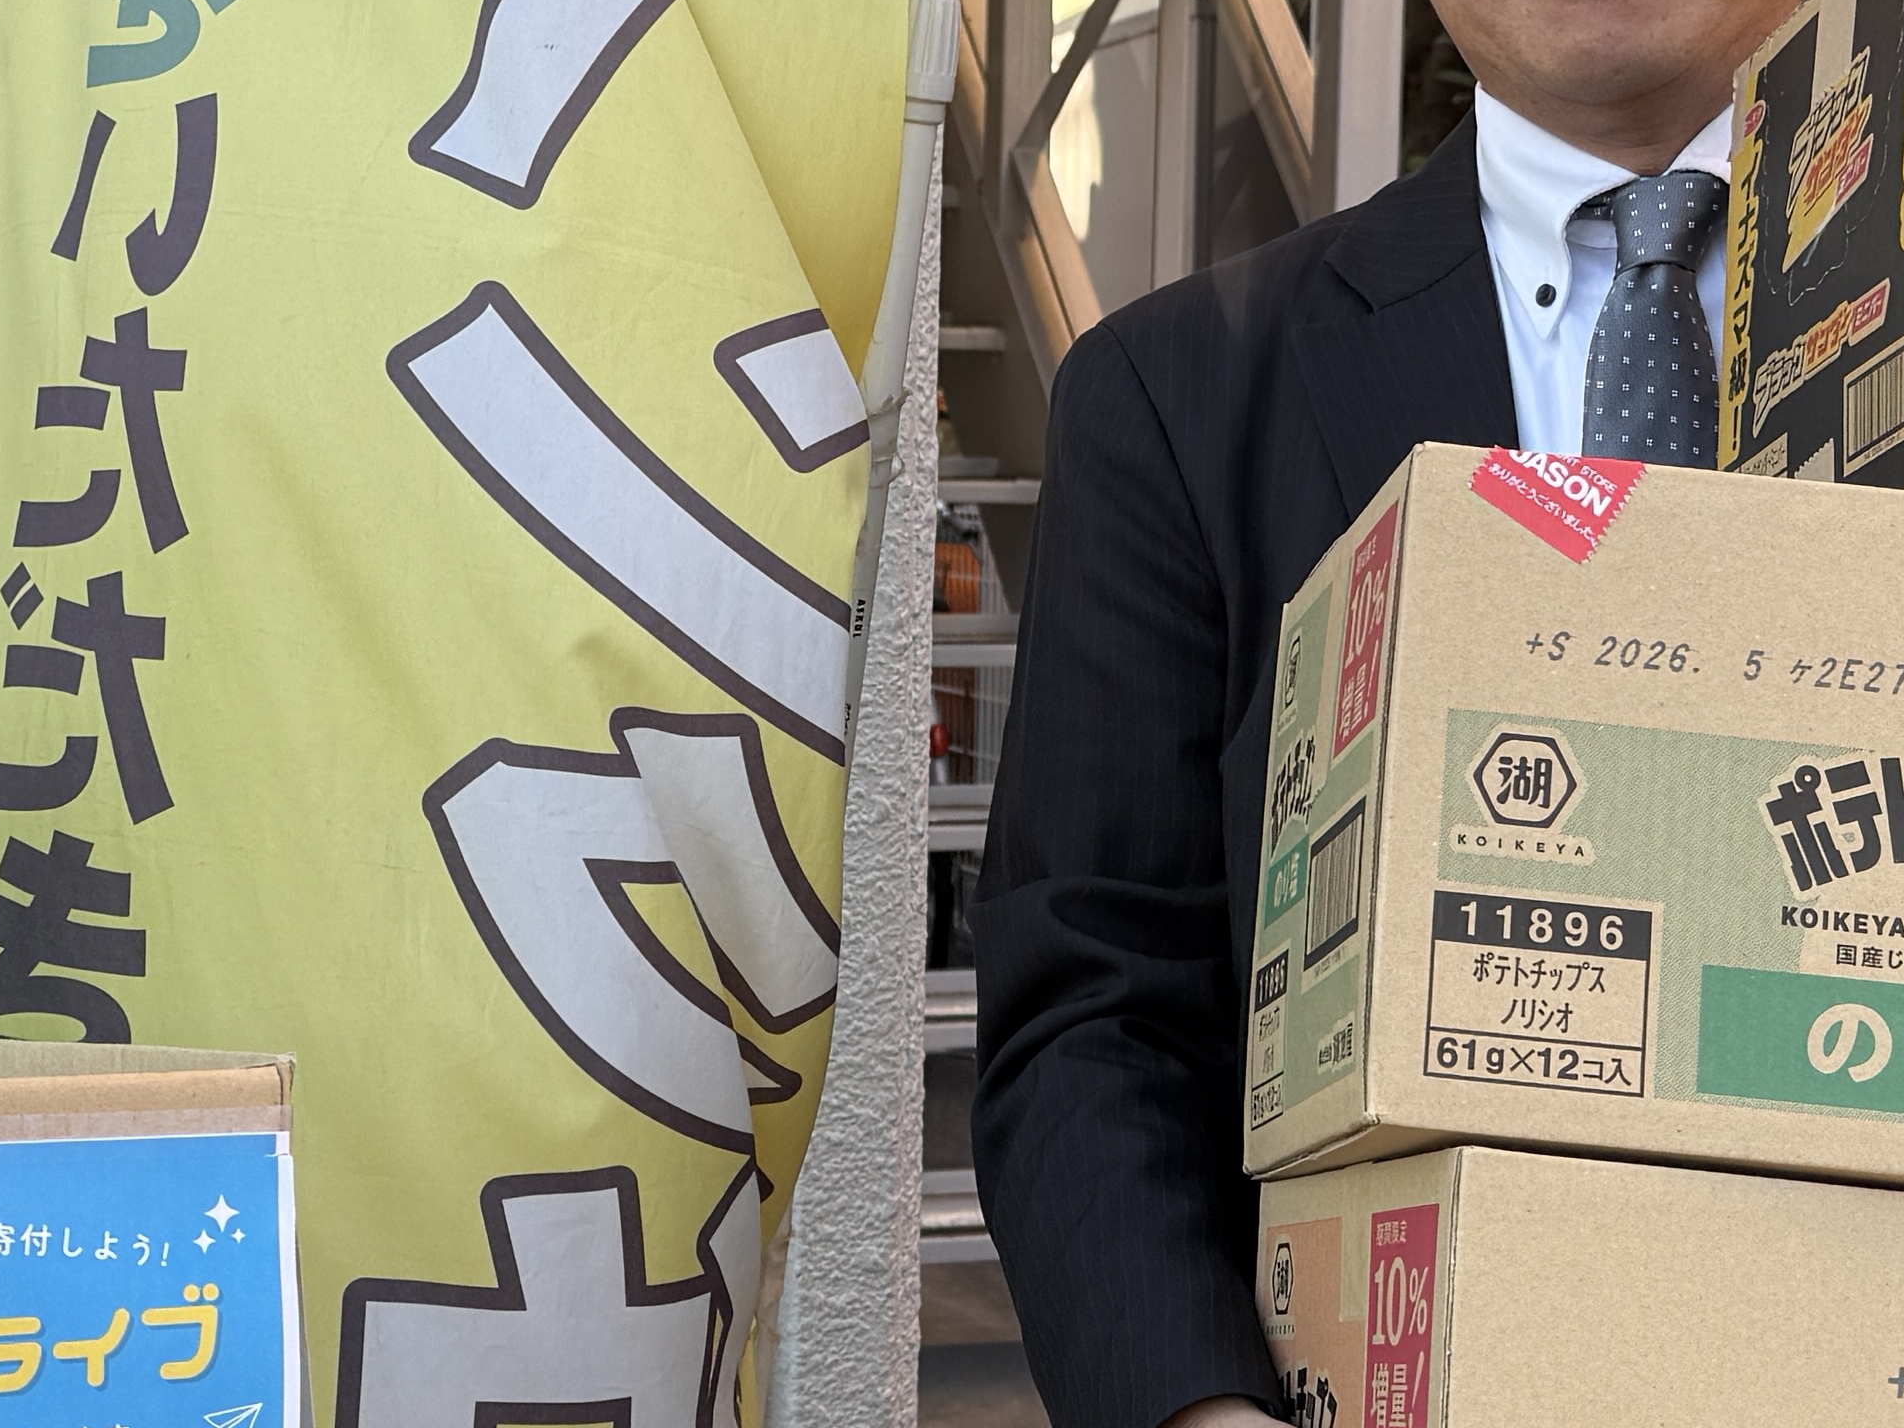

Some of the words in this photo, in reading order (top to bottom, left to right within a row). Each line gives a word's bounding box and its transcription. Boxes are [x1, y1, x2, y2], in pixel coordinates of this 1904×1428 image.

[1595, 634, 1703, 674] 2026.
[1742, 650, 1764, 681] 5
[1497, 755, 1553, 811] 湖
[1456, 832, 1586, 859] KOIKEYA
[1458, 900, 1626, 950] 11896
[1471, 952, 1608, 994] ポテトチップス
[1499, 998, 1575, 1035] ノリシオ
[1434, 1036, 1633, 1087] 61g×12コ入
[1371, 1255, 1430, 1347] 10%
